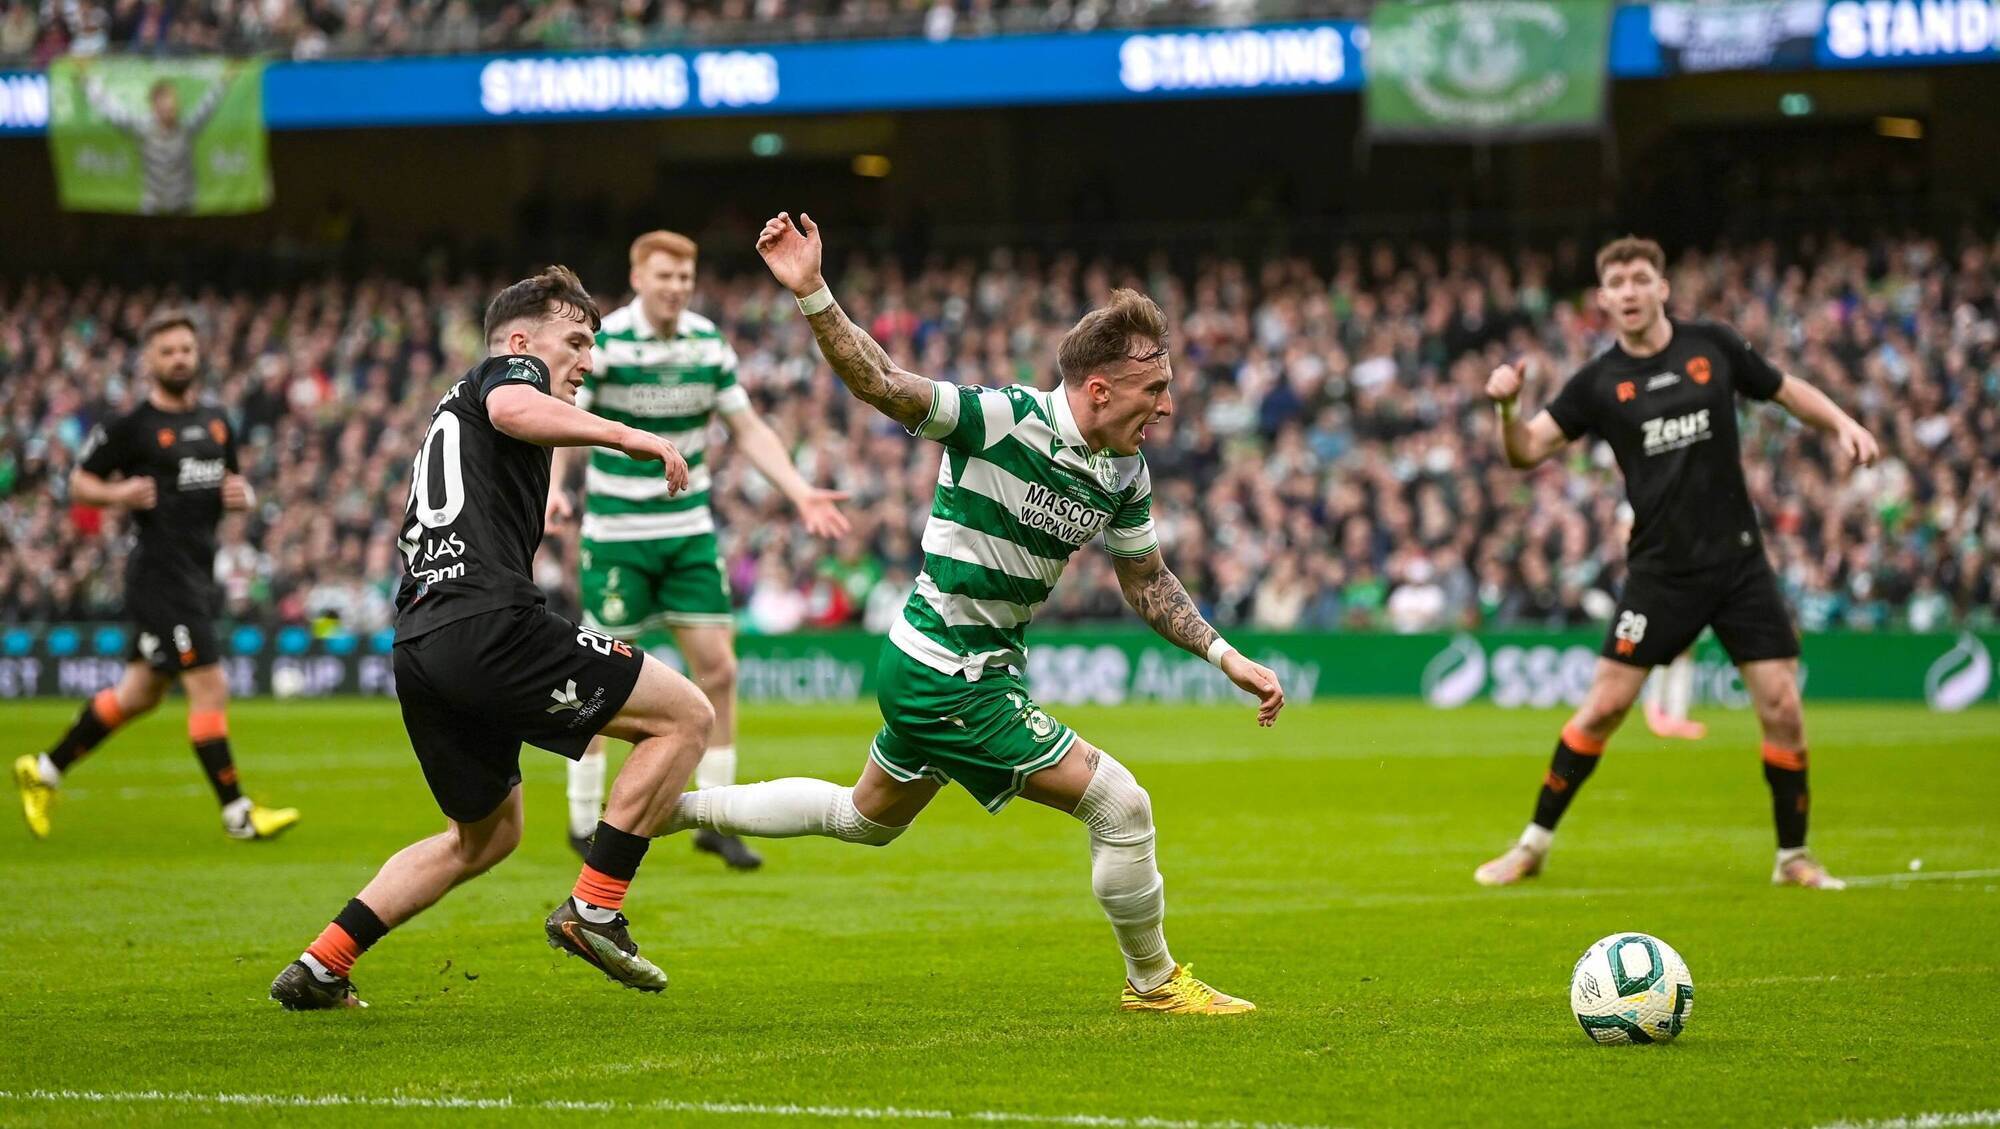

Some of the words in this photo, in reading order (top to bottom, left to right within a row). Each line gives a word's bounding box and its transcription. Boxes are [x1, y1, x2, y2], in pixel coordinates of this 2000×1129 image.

[1119, 26, 1344, 91] STANDING
[480, 55, 689, 114] STANDING
[1641, 408, 1710, 449] Zeus
[405, 410, 465, 528] 0
[1024, 484, 1106, 530] MASCOT
[1616, 610, 1647, 643] 28
[579, 686, 605, 717] SECOURS
